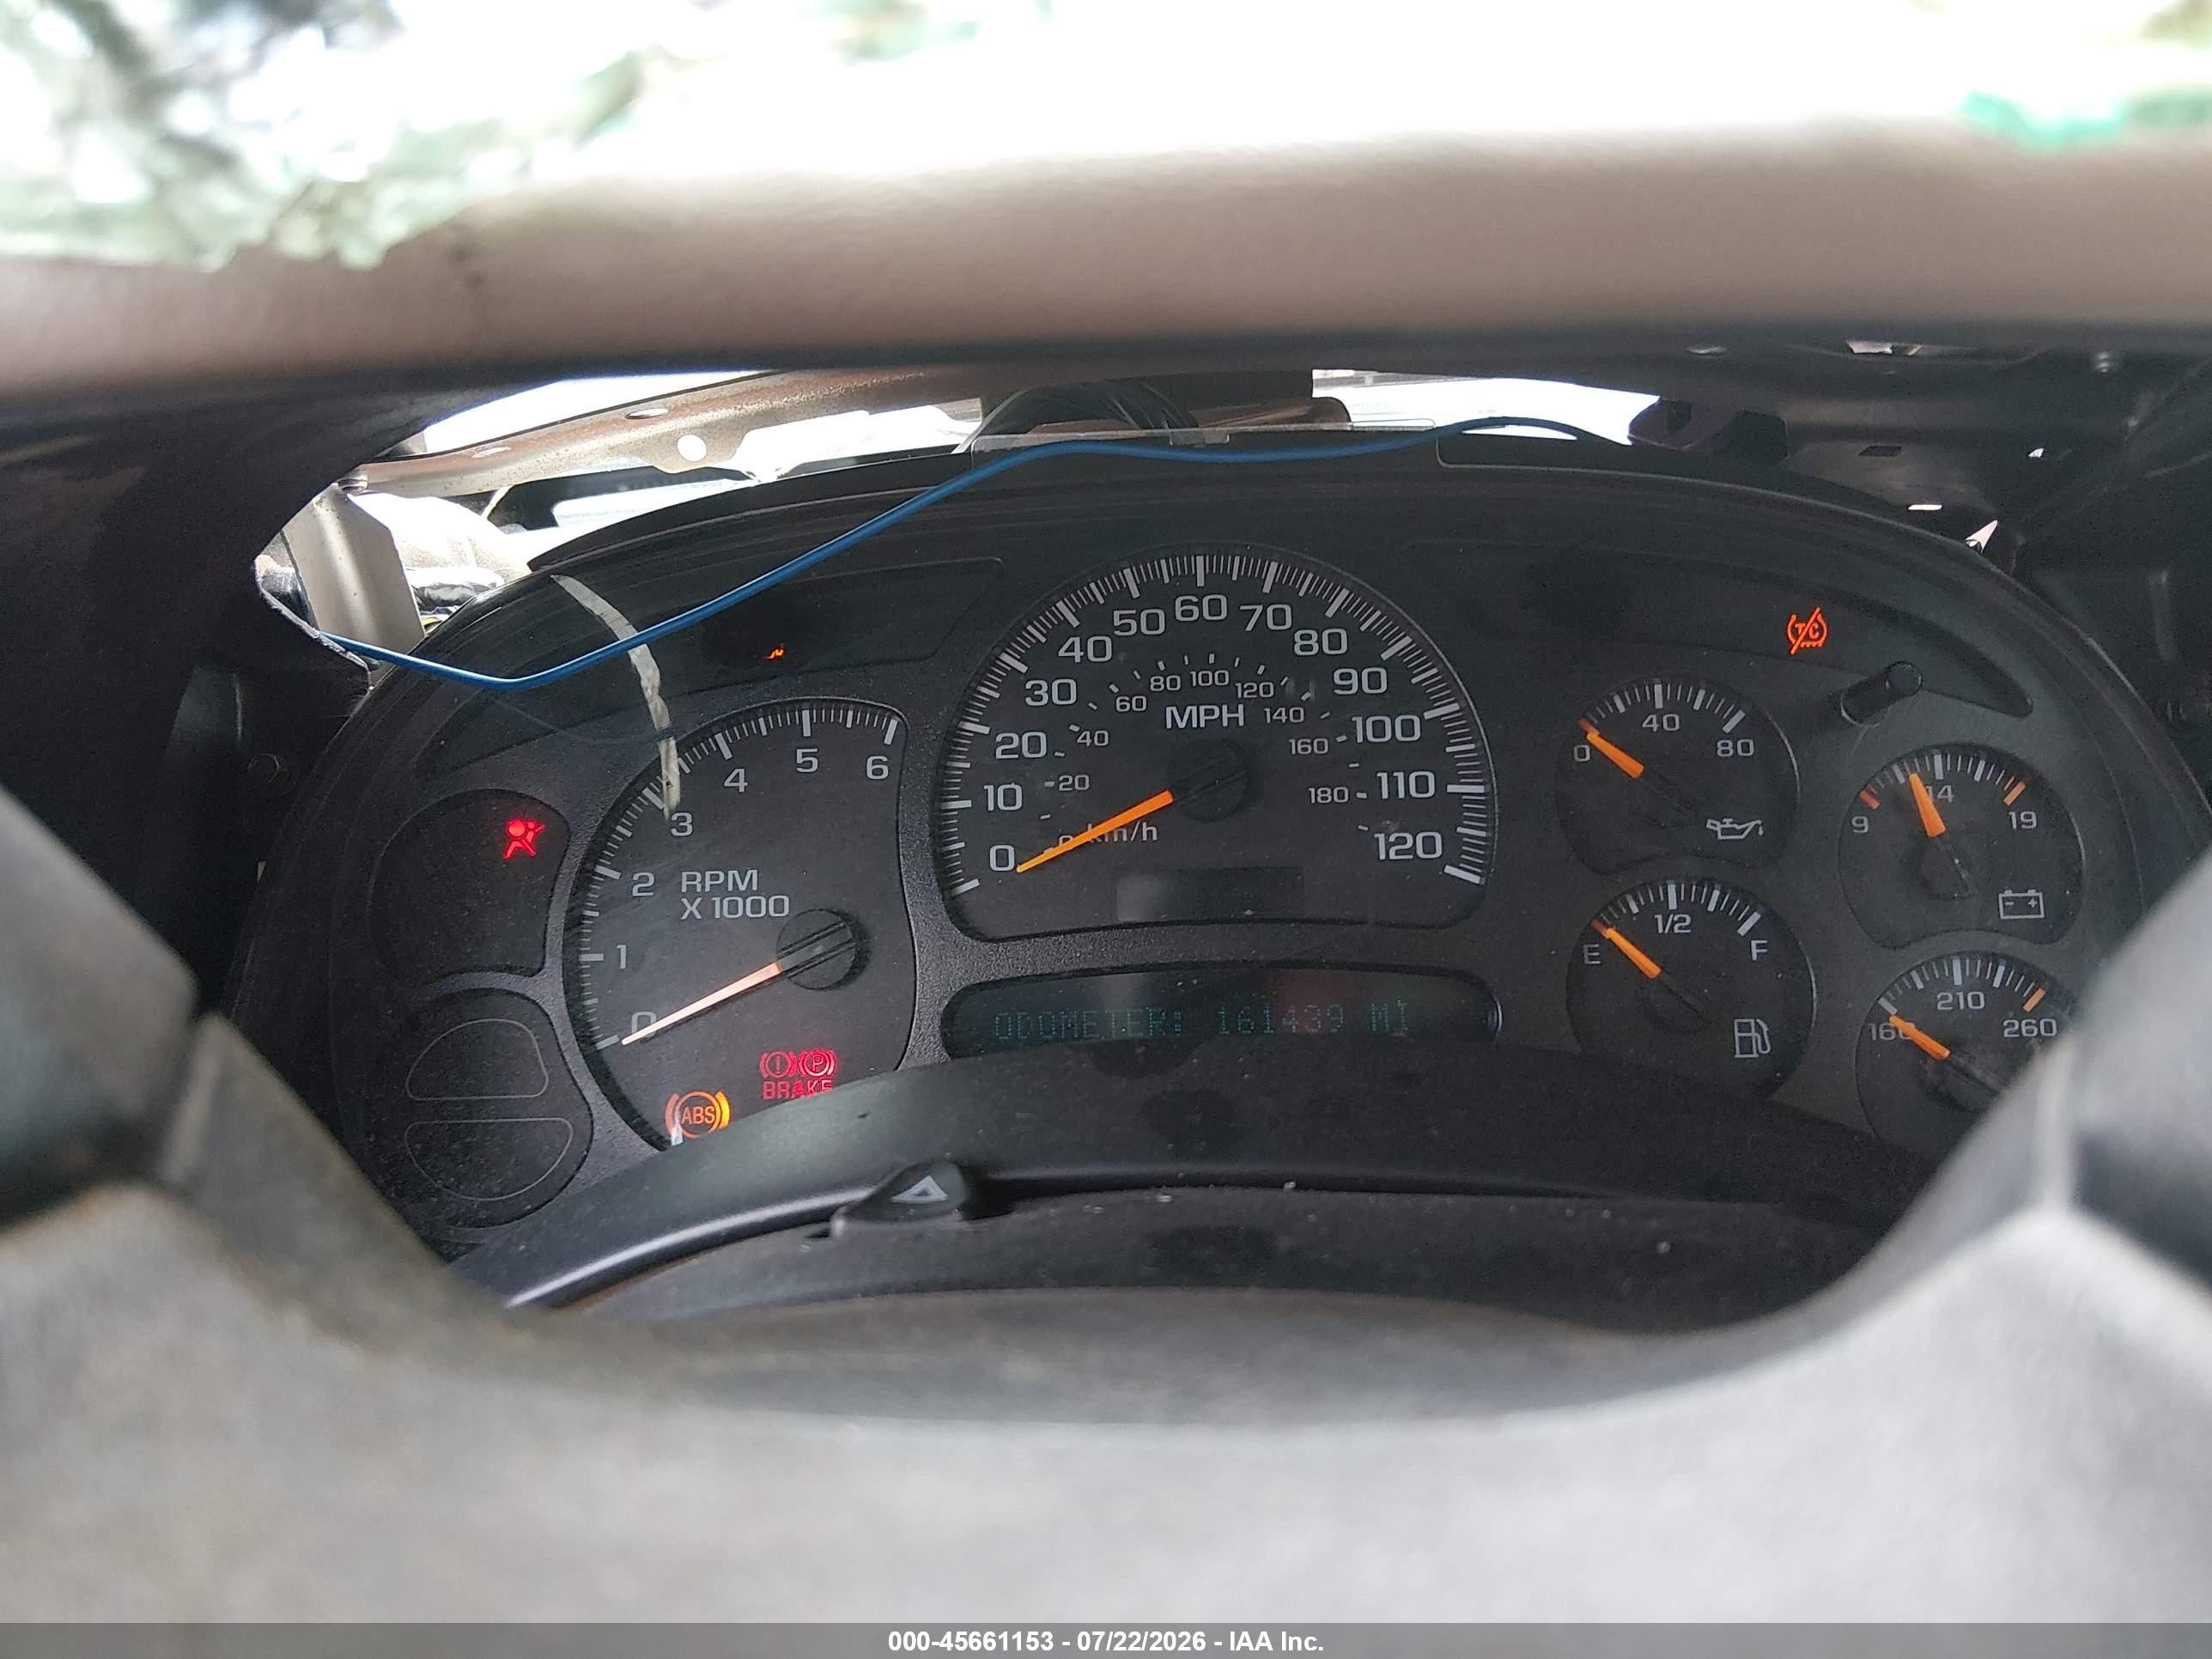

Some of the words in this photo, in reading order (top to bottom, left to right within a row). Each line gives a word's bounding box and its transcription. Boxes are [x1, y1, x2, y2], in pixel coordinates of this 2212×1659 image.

[1175, 595, 1228, 621] 60
[1240, 604, 1292, 631] 70
[1113, 609, 1166, 636] 50
[1058, 635, 1112, 663] 40
[1293, 629, 1347, 656] 80
[1150, 675, 1182, 692] 80
[1190, 670, 1230, 686] 100
[1333, 667, 1388, 695] 90
[1025, 678, 1078, 706] 30
[1236, 682, 1274, 699] 120
[1115, 695, 1147, 713] 60
[1165, 704, 1245, 729] MPH
[1264, 707, 1305, 724] 140
[1642, 714, 1680, 732] 40
[1077, 730, 1109, 747] 40
[1352, 714, 1422, 743] 100
[995, 732, 1047, 759] 20
[1290, 738, 1328, 755] 160
[1573, 744, 1591, 763] 0
[1717, 739, 1755, 757] 80
[796, 748, 818, 773] 5
[866, 756, 889, 780] 6
[724, 769, 748, 793] 4
[1058, 774, 1090, 791] 20
[1377, 771, 1436, 799] 110
[984, 784, 1023, 811] 10
[1309, 787, 1349, 804] 180
[671, 812, 694, 836] 3
[1851, 816, 1869, 833] 9
[2009, 811, 2038, 830] 19
[1375, 832, 1443, 860] 120
[989, 844, 1015, 872] 0
[632, 872, 654, 896] 2
[681, 870, 758, 891] RPM
[680, 898, 702, 920] X
[714, 895, 790, 919] 1000
[1655, 914, 1691, 934] 1/2
[617, 945, 627, 969] 1
[1583, 945, 1601, 964] E
[1750, 940, 1768, 961] F
[1936, 991, 1985, 1010] 210
[1371, 1000, 1407, 1033] MI
[2002, 1018, 2057, 1038] 260
[763, 1079, 833, 1100] BRAKE
[682, 1106, 715, 1124] ABS
